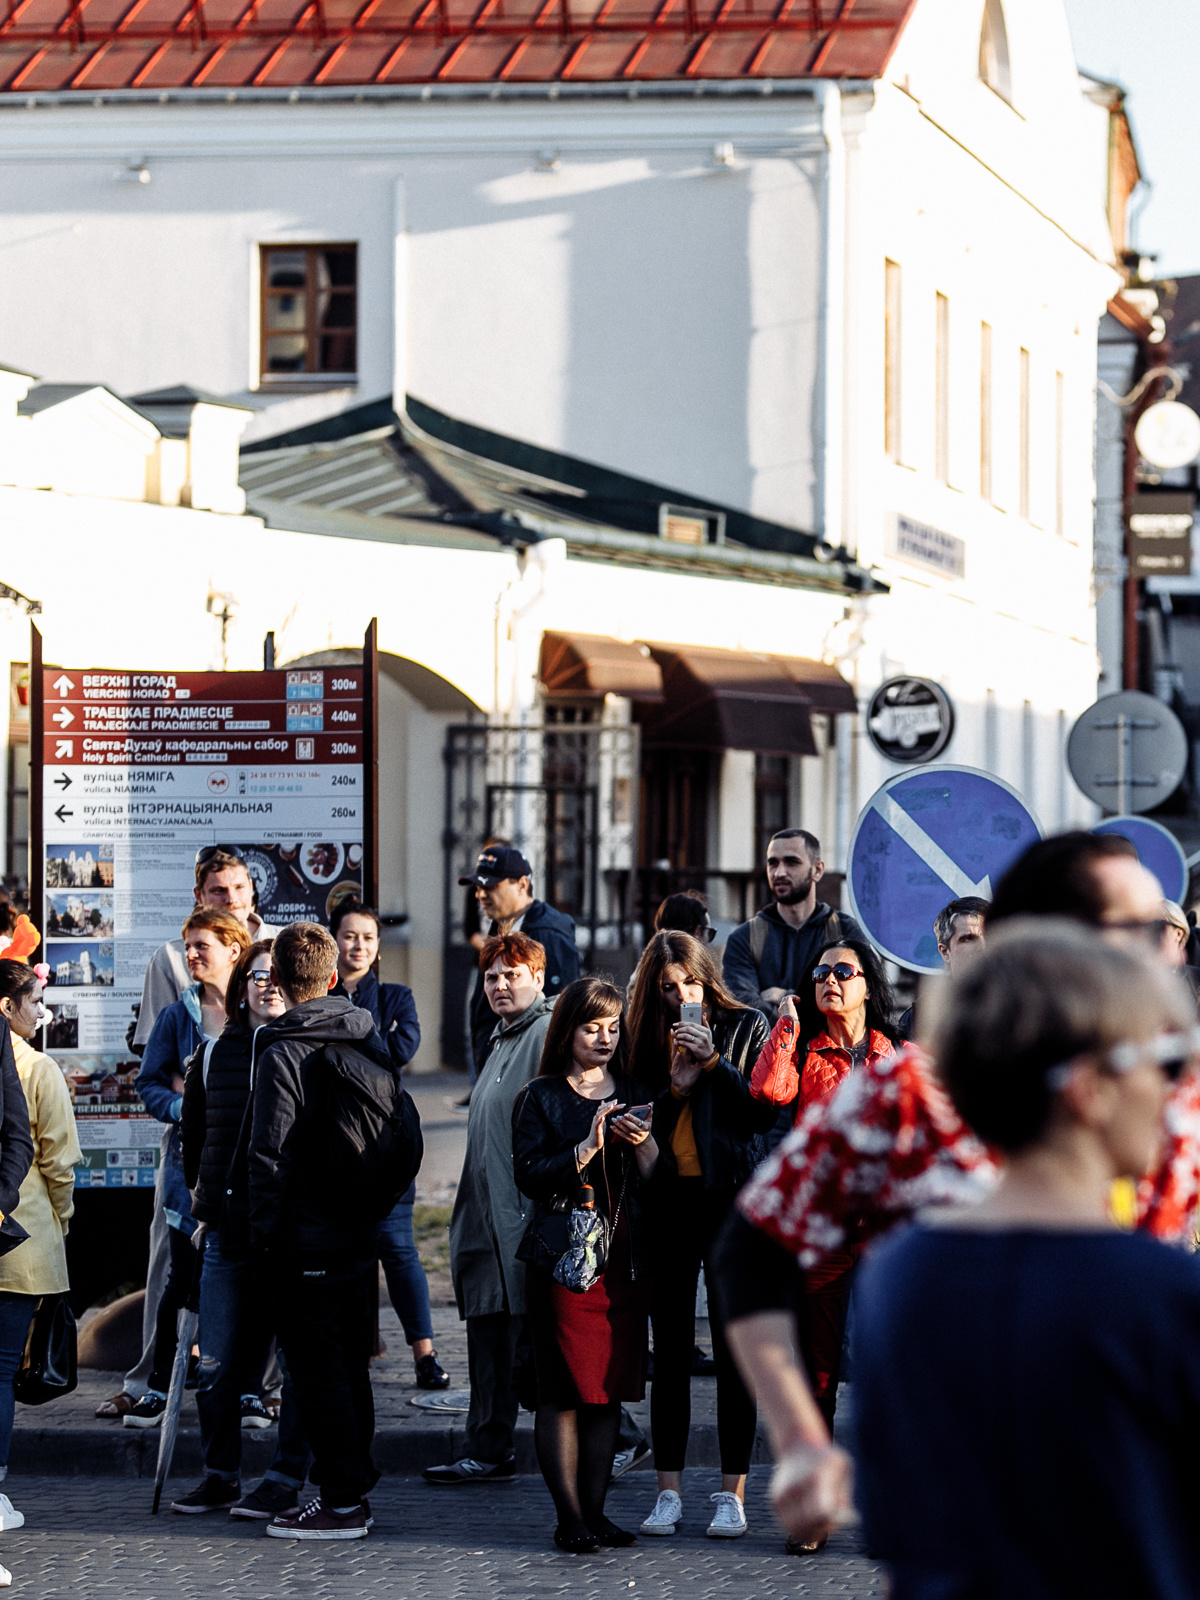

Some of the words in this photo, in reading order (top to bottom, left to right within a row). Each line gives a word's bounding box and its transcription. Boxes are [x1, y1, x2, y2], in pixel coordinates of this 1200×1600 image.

[82, 675, 130, 687] ВЕРХНІ
[132, 675, 177, 689] ГОРАД
[331, 679, 357, 690] 300м
[83, 689, 131, 698] VIERCHNI
[133, 689, 170, 698] HORAD
[83, 706, 151, 720] ТРАЕЦКАЕ
[154, 706, 233, 720] ПРАДМЕСЦЕ
[331, 710, 357, 722] 440м
[83, 720, 149, 730] TRAJECKAJE
[82, 738, 162, 753] Свята-Духаў
[165, 739, 251, 752] кафедральны
[254, 738, 288, 752] сабор
[331, 743, 357, 754] 300м
[82, 752, 105, 764] Holy
[106, 752, 132, 763] Spirit
[134, 753, 180, 762] Cathedral
[83, 772, 123, 784] вуліца
[127, 771, 175, 781] НЯМІГА
[331, 775, 356, 786] 240м
[84, 785, 111, 793] vulica
[114, 785, 156, 793] NIAMIHA
[83, 804, 123, 815] вуліца
[127, 803, 273, 815] ІНТЭРНАЦЫЯНАЛЬНАЯ
[331, 807, 356, 818] 260м
[277, 903, 306, 913] ДОБРО
